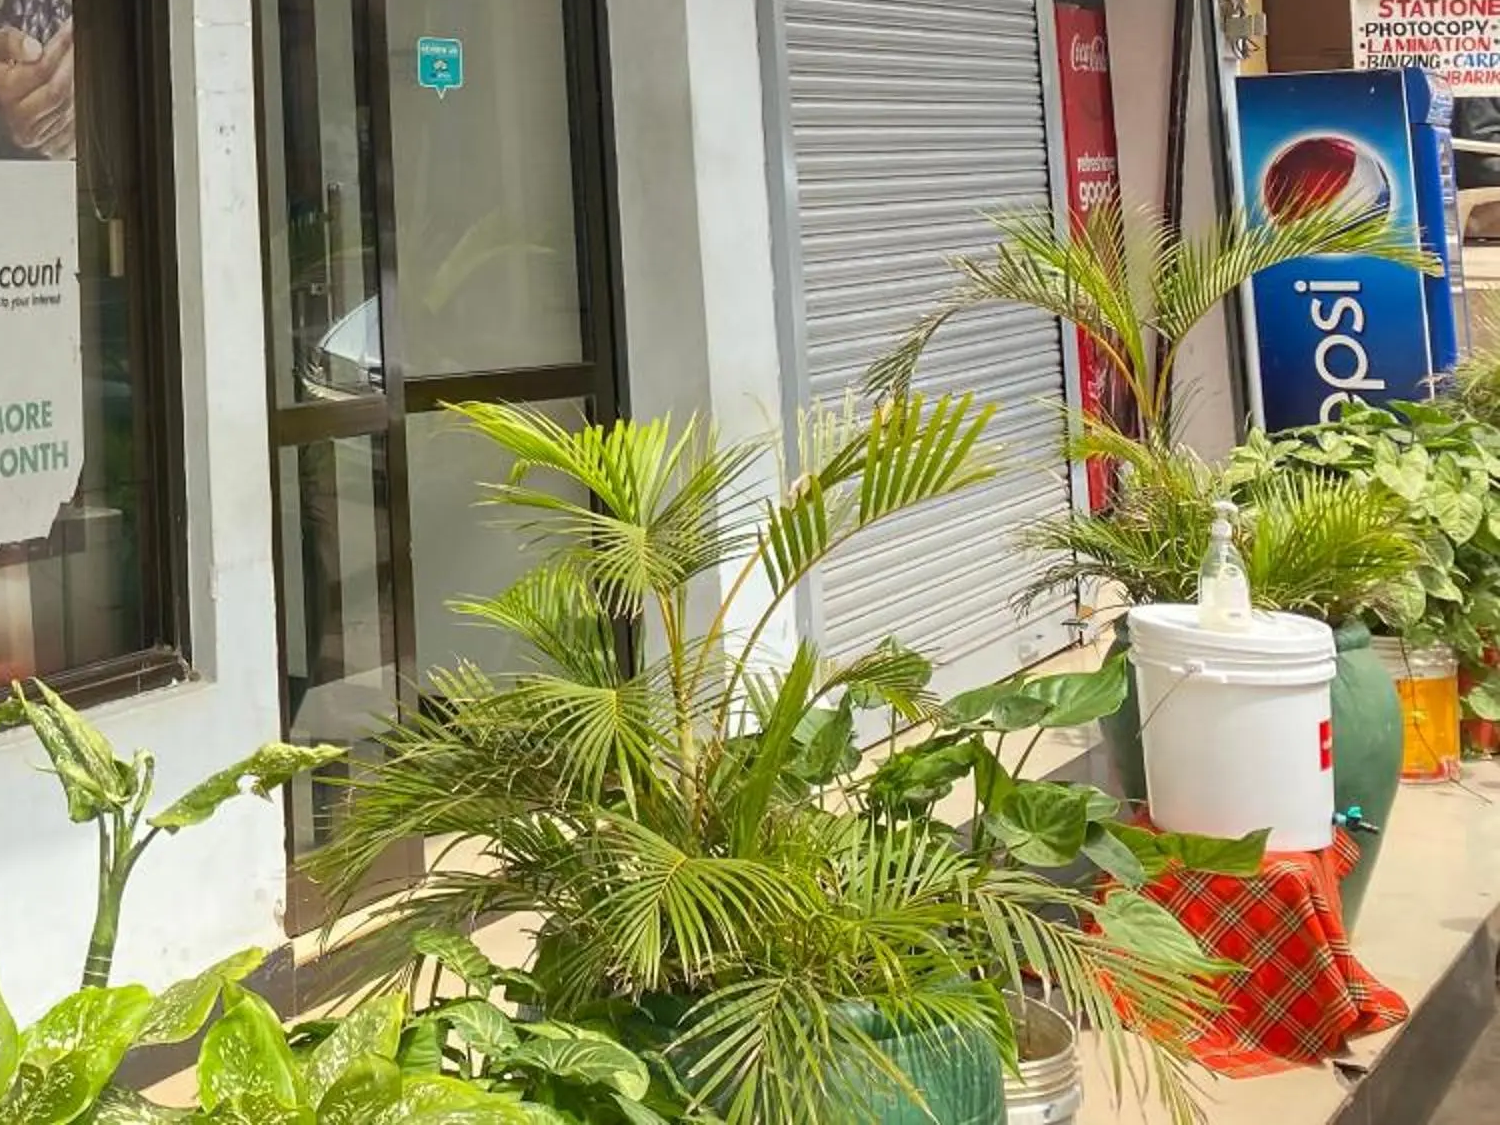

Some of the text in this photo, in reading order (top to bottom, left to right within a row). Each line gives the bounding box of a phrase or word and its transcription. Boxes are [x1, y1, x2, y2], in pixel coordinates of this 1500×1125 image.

[1365, 19, 1489, 37] PHOTOCOPY
[1367, 36, 1491, 53] LAMINATION
[1367, 54, 1441, 69] BINDING
[1079, 174, 1112, 212] good
